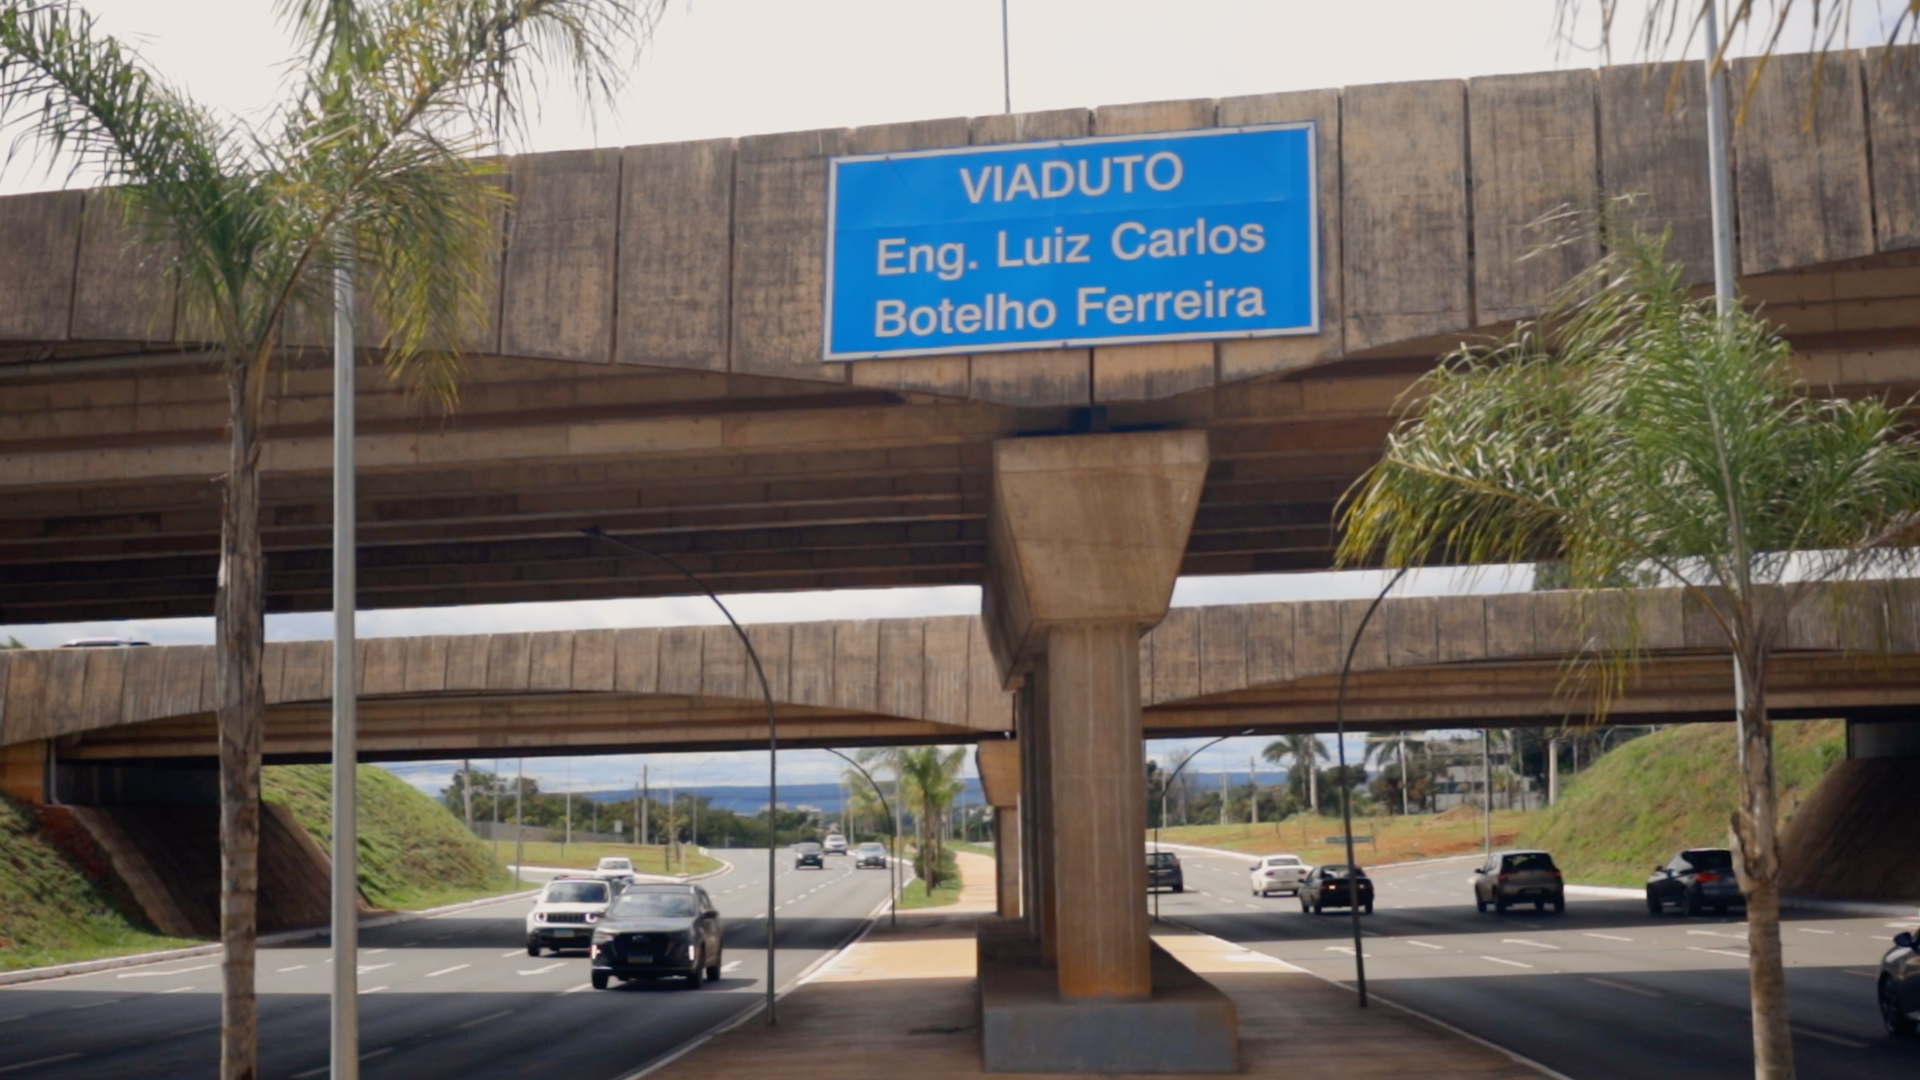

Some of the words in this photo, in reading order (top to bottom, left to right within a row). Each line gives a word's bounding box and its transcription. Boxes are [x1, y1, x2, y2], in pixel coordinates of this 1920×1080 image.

[959, 151, 1183, 204] VIADUTO
[877, 238, 978, 281] Eng.
[997, 227, 1090, 268] Luiz
[1111, 219, 1265, 261] Carlos
[875, 293, 1057, 338] Botelho
[1077, 280, 1266, 326] Ferreira
